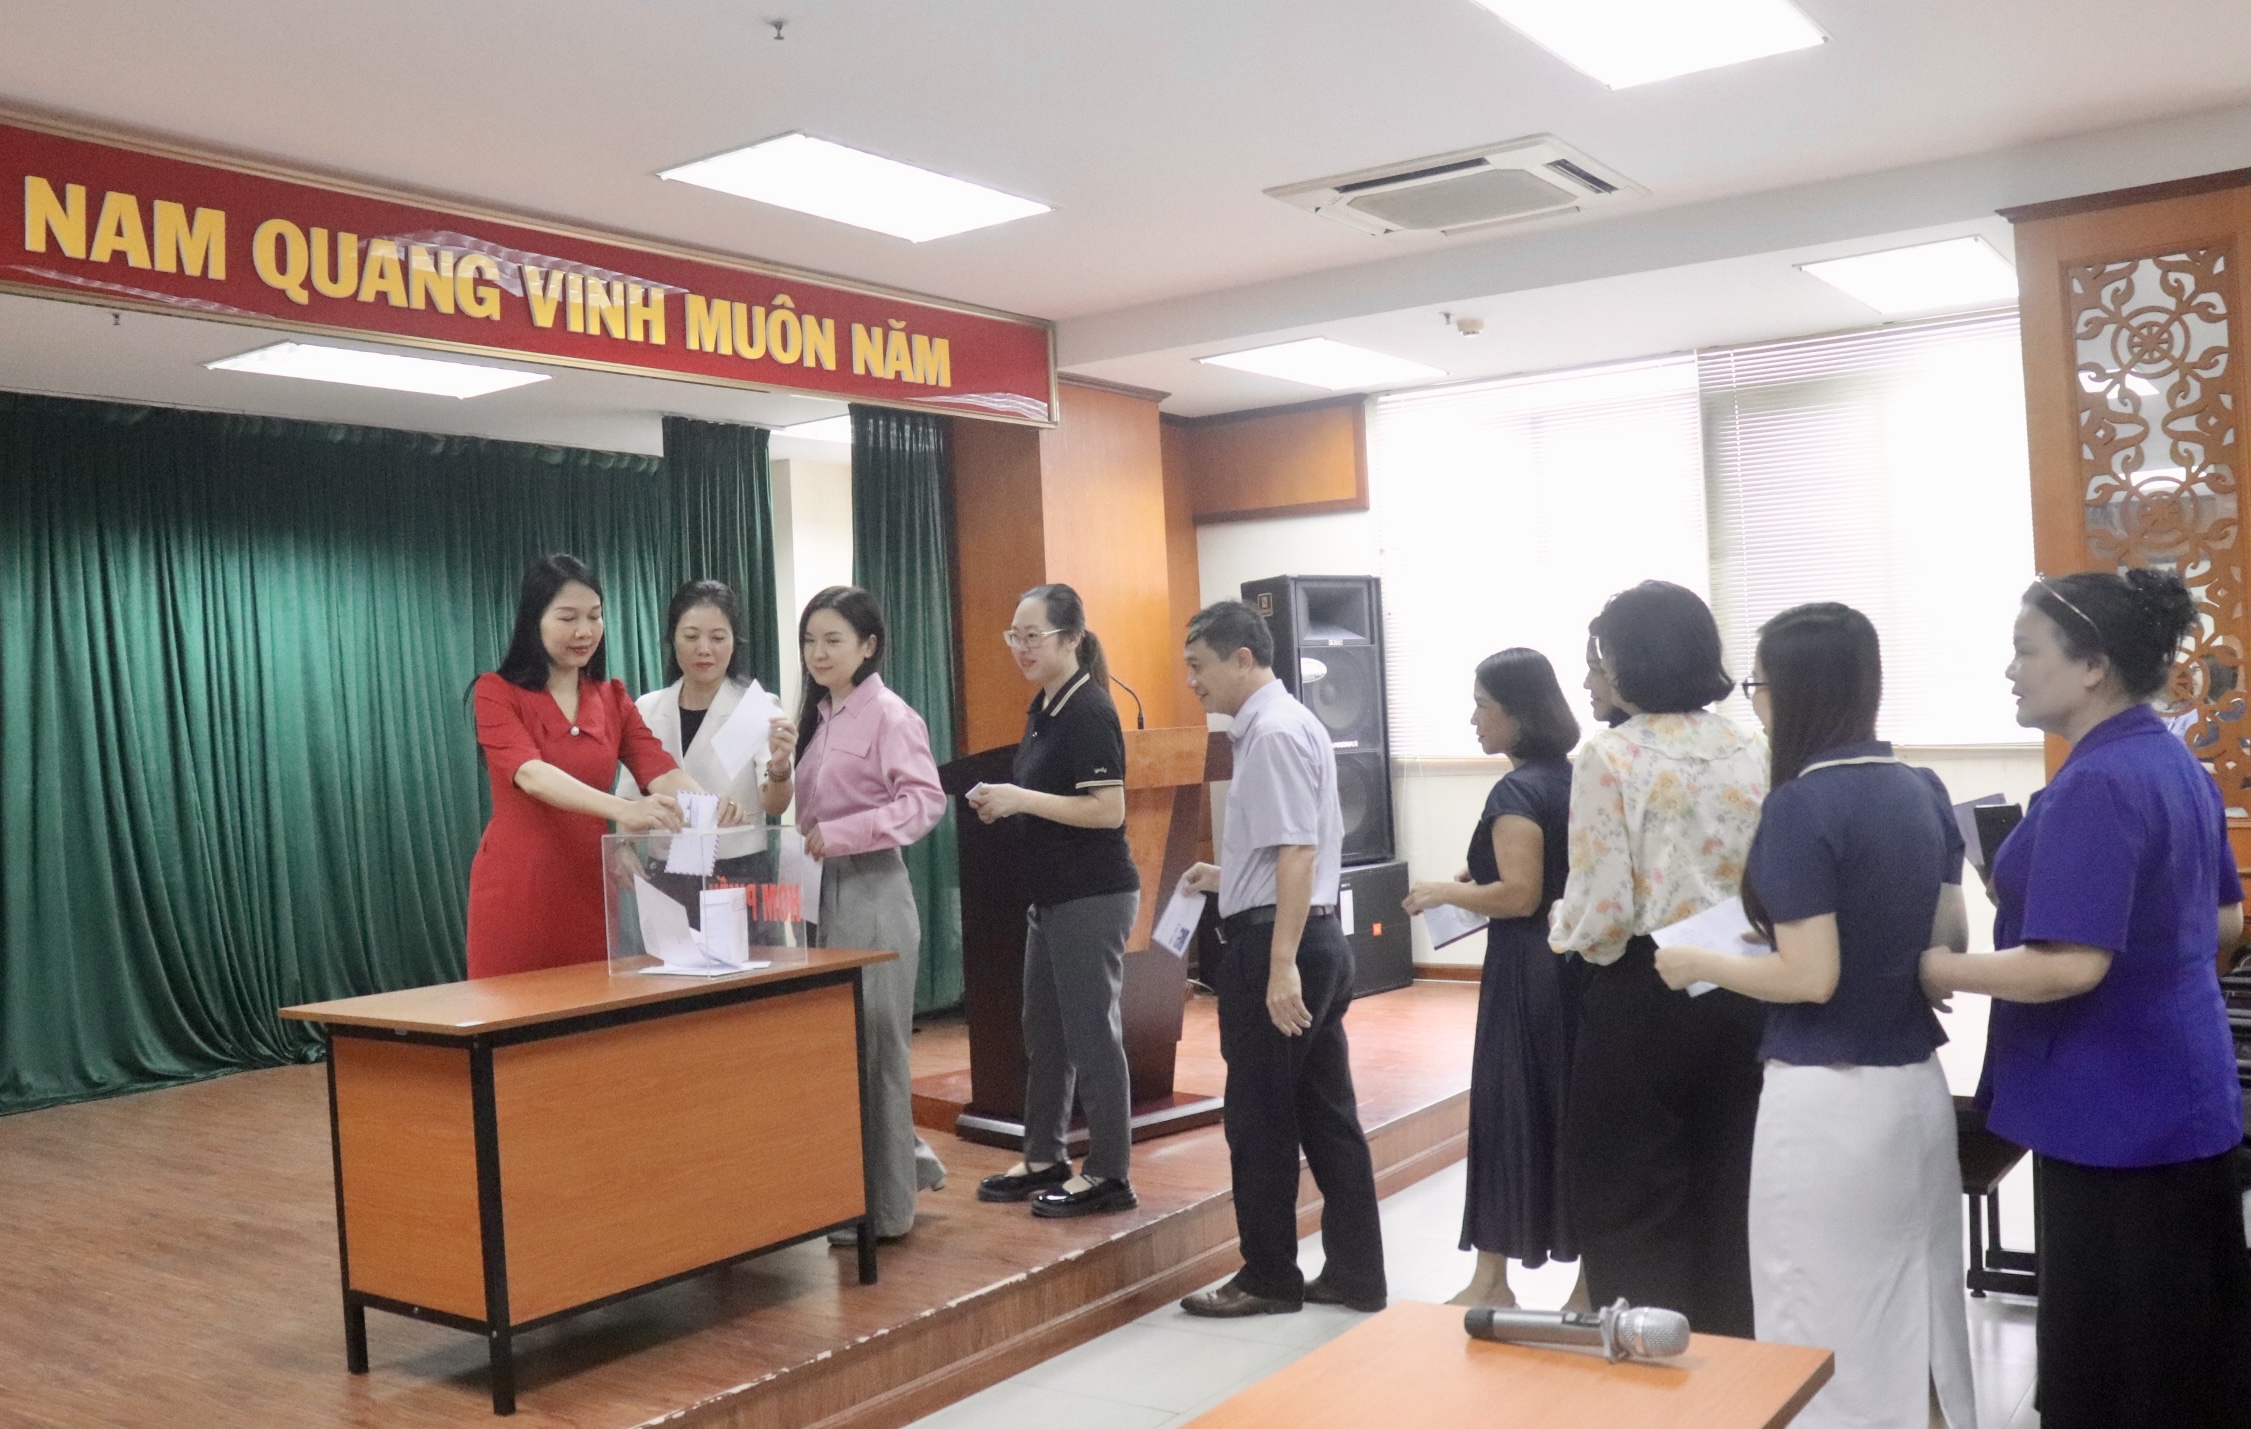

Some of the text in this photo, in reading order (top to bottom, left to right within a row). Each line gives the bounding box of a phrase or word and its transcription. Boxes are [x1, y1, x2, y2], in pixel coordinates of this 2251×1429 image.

[25, 175, 951, 388] NAM QUANG VINH MUÔN NĂM
